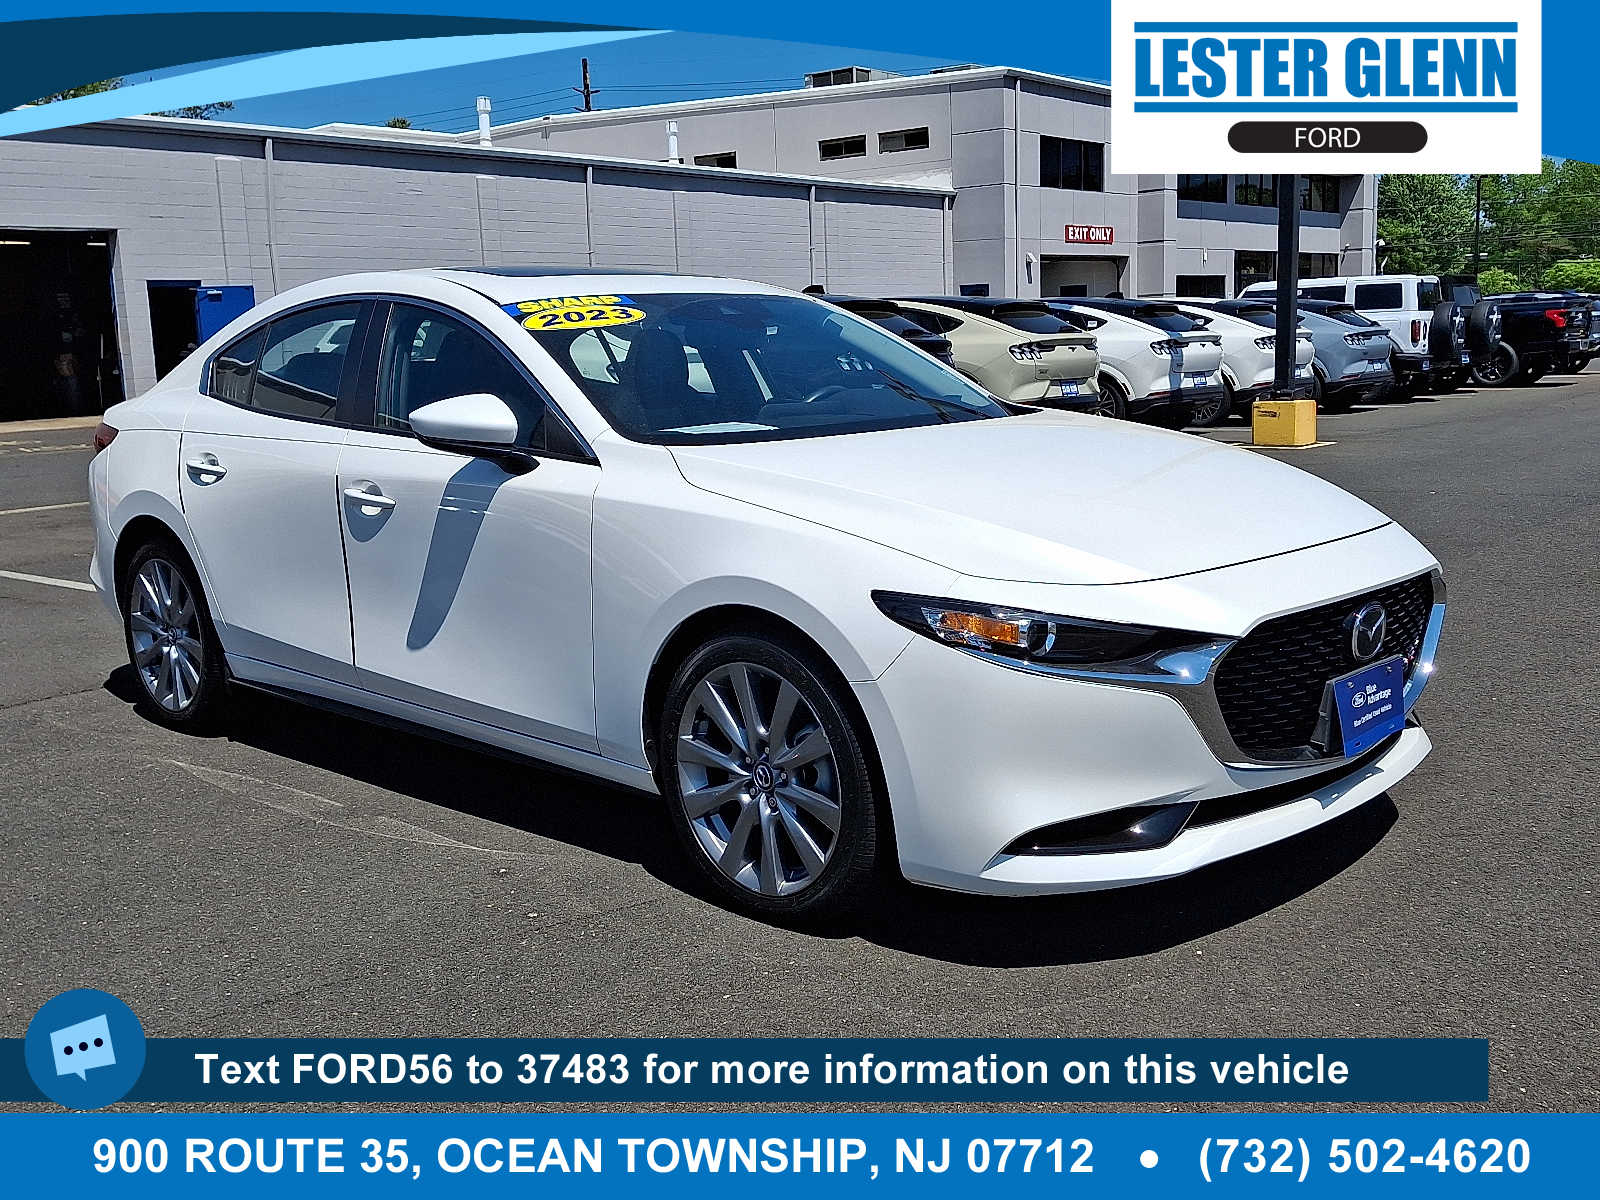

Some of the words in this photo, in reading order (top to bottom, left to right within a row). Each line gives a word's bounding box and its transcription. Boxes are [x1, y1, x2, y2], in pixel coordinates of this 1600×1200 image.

[1068, 226, 1089, 240] EXIT
[1090, 227, 1111, 240] ONLY
[516, 295, 622, 313] SHARP
[538, 308, 633, 328] 2023
[1366, 683, 1378, 695] Blue
[1367, 688, 1392, 705] Advantage
